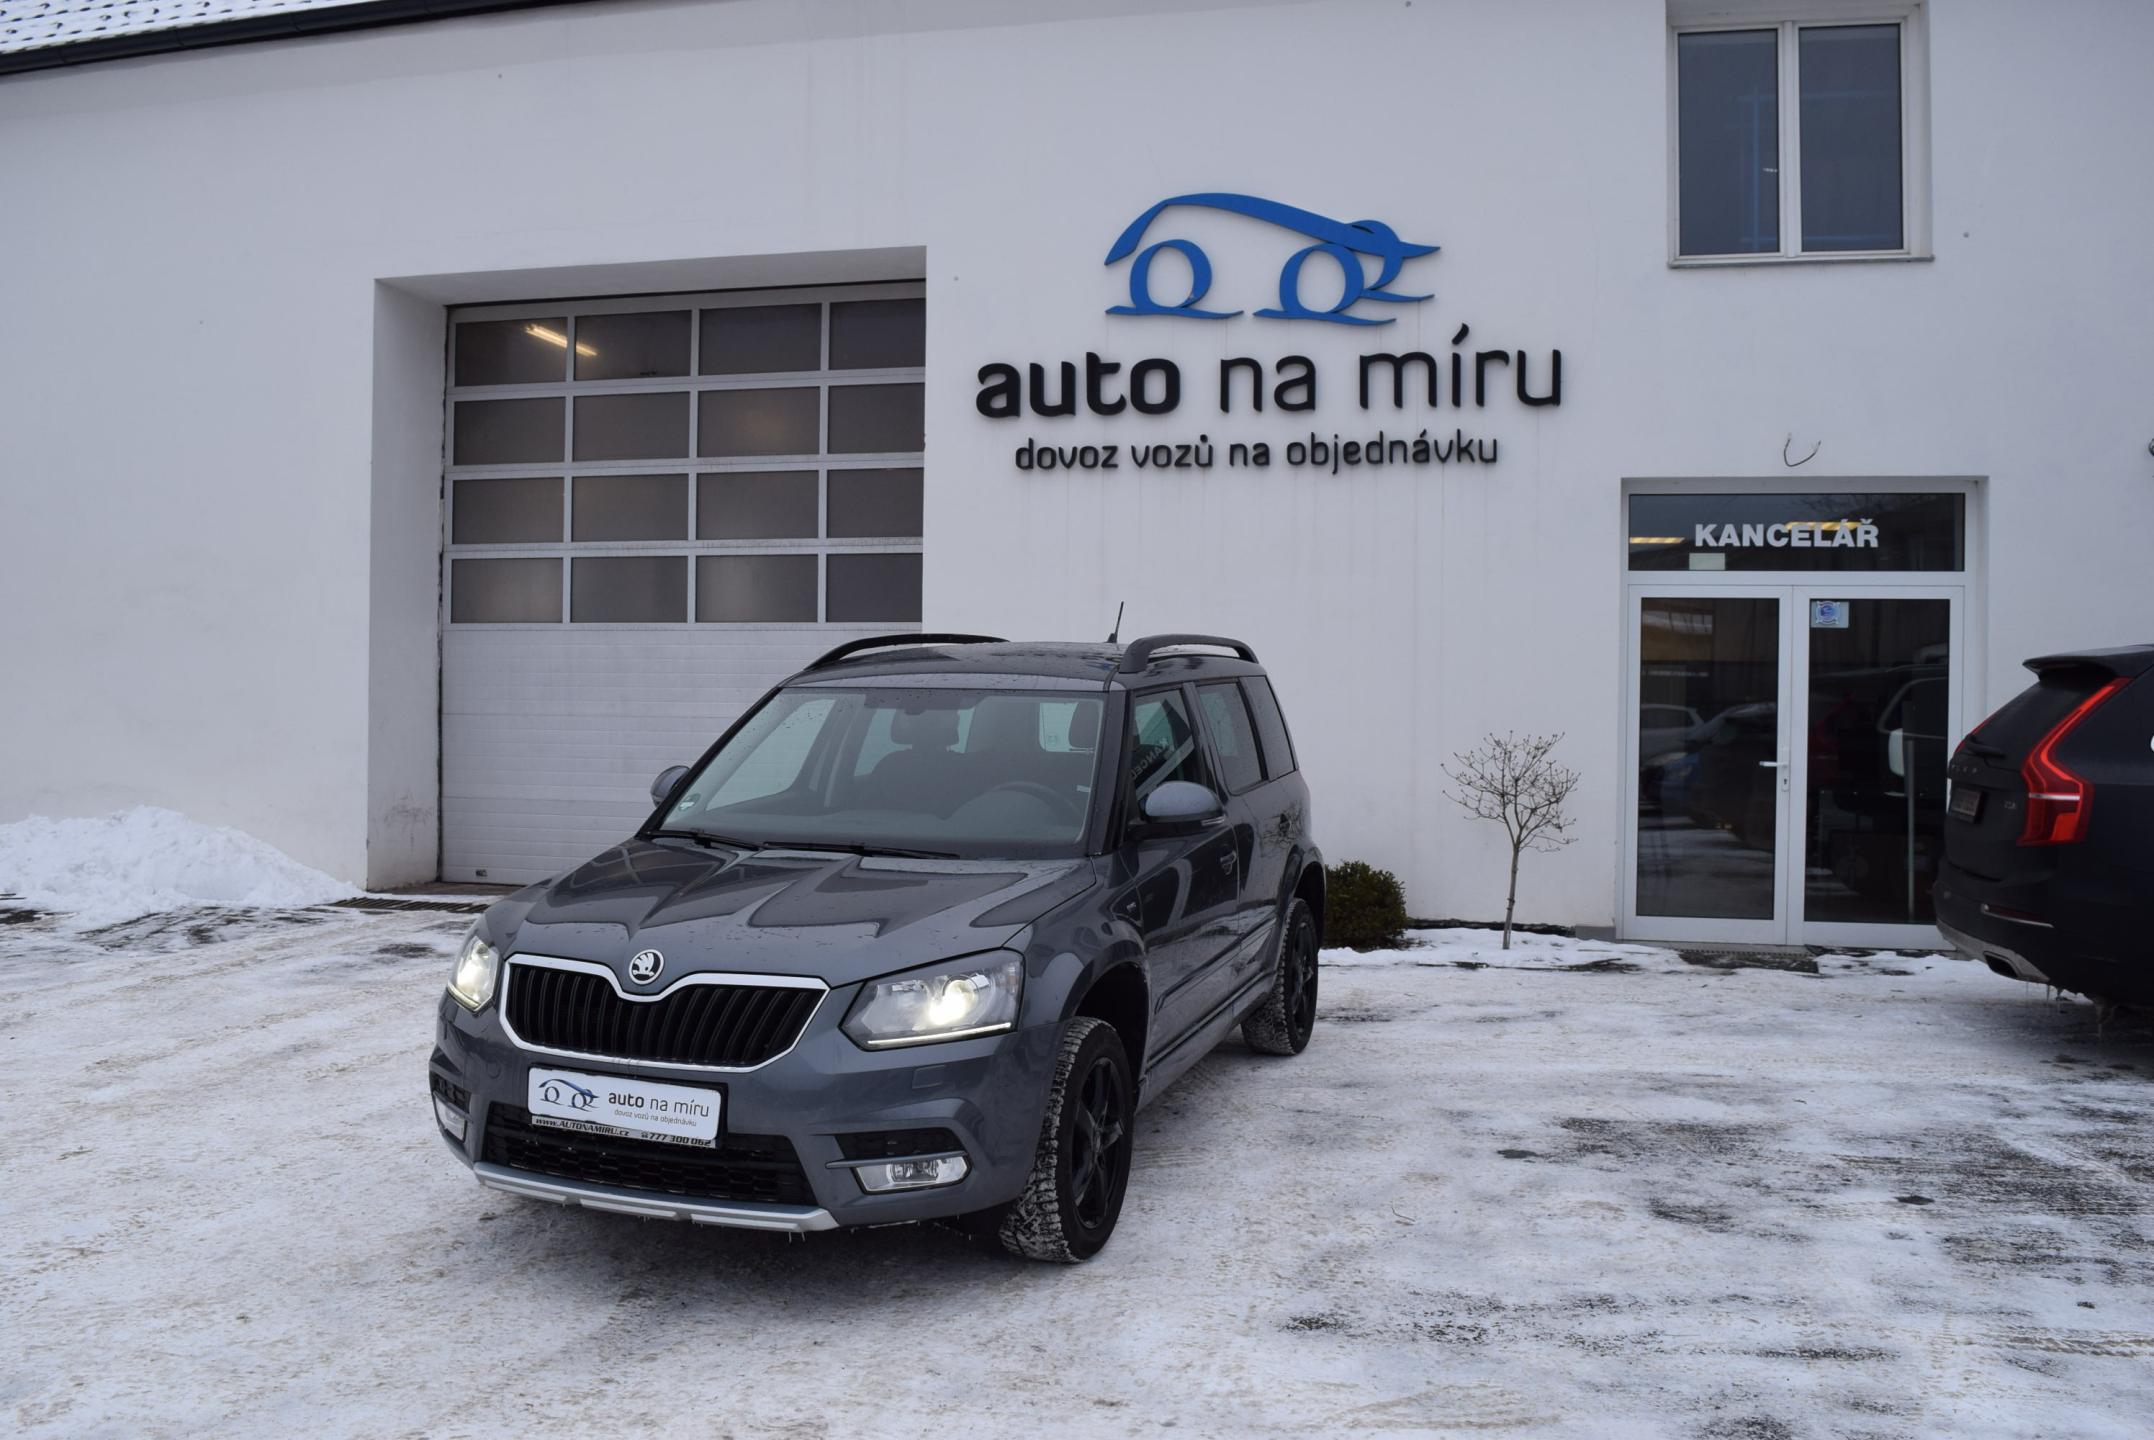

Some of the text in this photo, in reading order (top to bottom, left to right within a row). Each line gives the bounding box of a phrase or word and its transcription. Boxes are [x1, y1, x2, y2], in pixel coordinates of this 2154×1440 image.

[976, 322, 1562, 419] auto na míru
[1015, 428, 1498, 475] dovoz vozů na objednávku
[1695, 518, 1879, 547] KANCELÁŘ
[608, 1092, 709, 1117] auto na míru
[614, 1108, 633, 1118] dovoz
[650, 1132, 667, 1141] 777
[671, 1135, 689, 1144] 300
